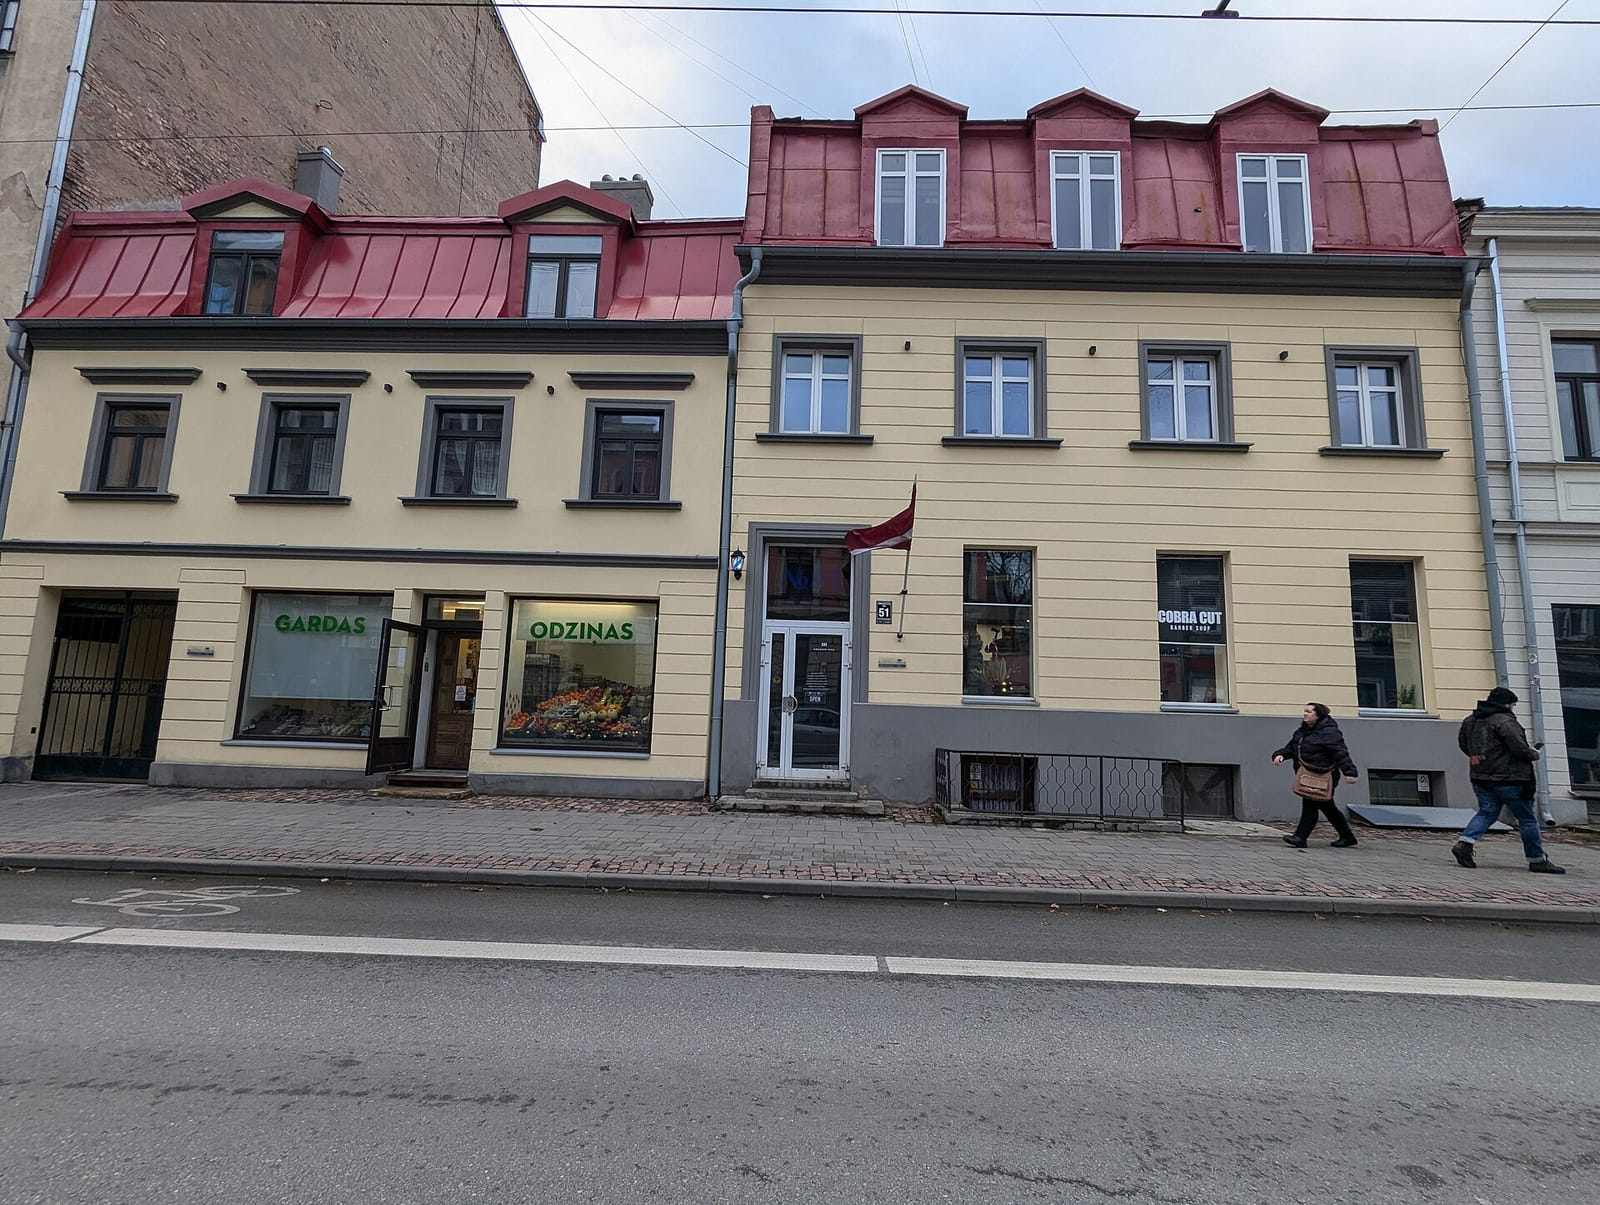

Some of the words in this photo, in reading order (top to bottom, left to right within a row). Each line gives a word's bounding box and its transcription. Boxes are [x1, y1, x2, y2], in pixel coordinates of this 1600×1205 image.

[878, 607, 889, 618] 51
[1158, 610, 1198, 624] COBRA
[1199, 611, 1223, 625] CUT
[274, 614, 366, 634] GARDAS
[529, 621, 634, 647] ODZIŅAS
